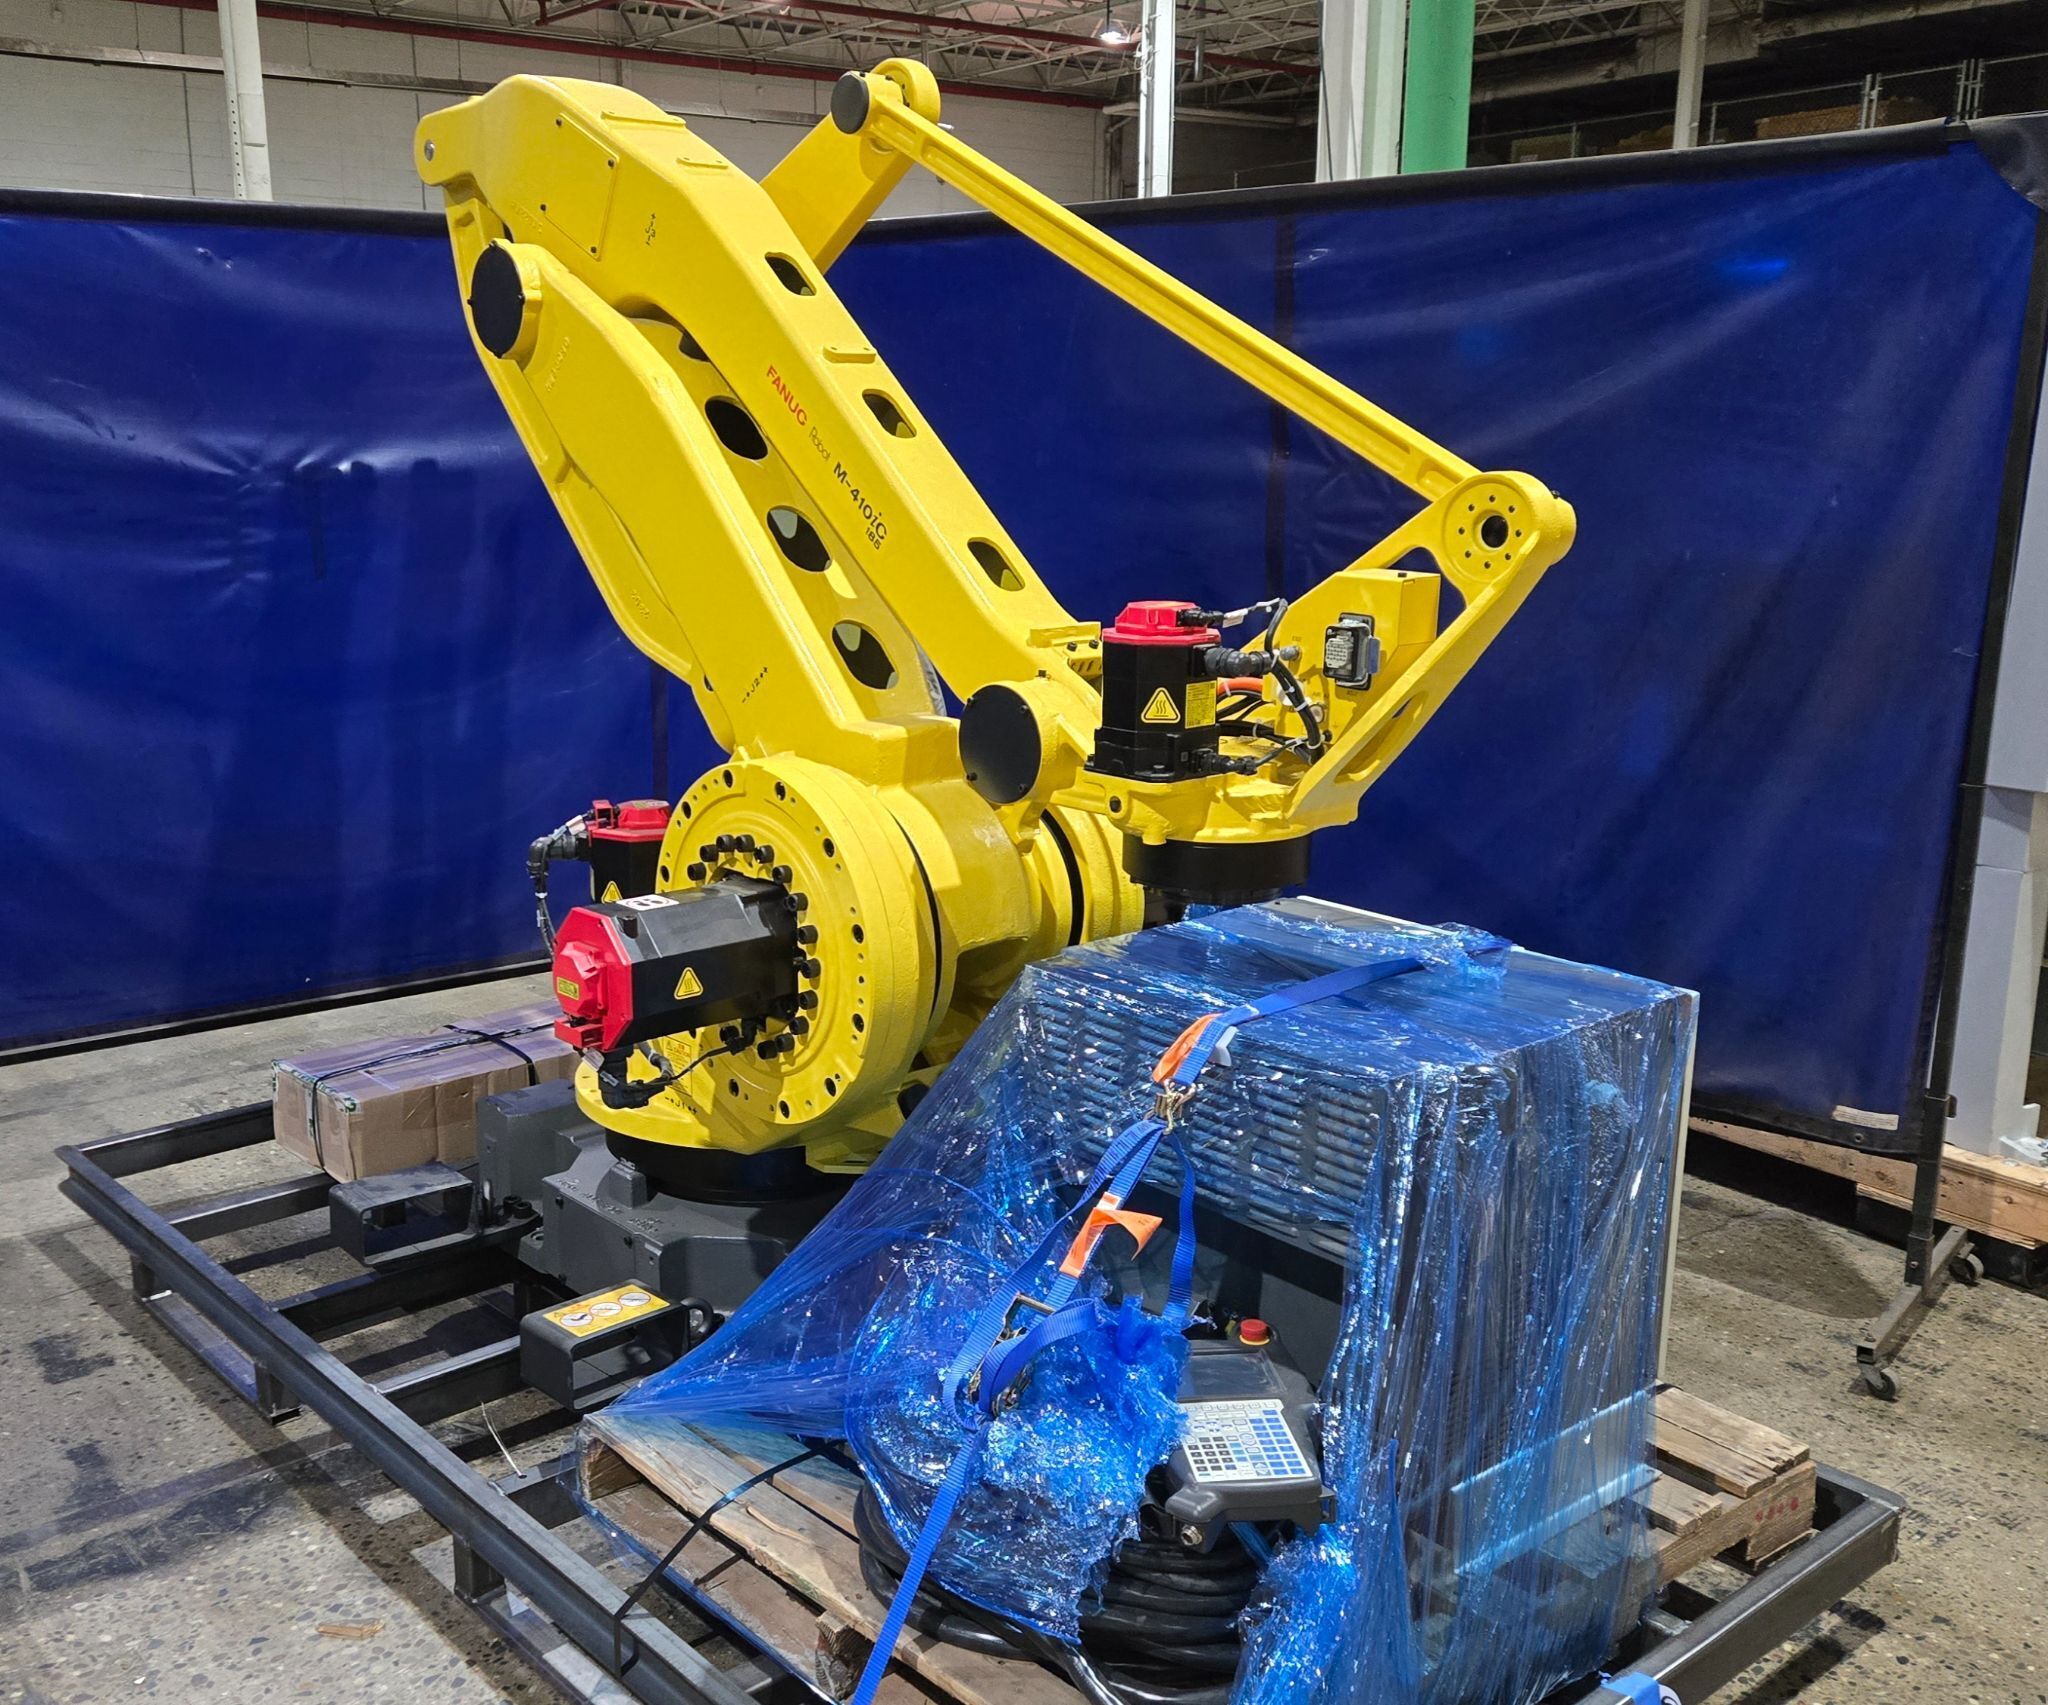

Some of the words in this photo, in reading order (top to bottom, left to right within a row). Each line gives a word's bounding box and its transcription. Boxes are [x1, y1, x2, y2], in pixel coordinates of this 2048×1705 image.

[766, 365, 808, 426] FANUC
[809, 426, 831, 462] Robot
[833, 461, 888, 541] M-410iC
[865, 527, 882, 551] 185
